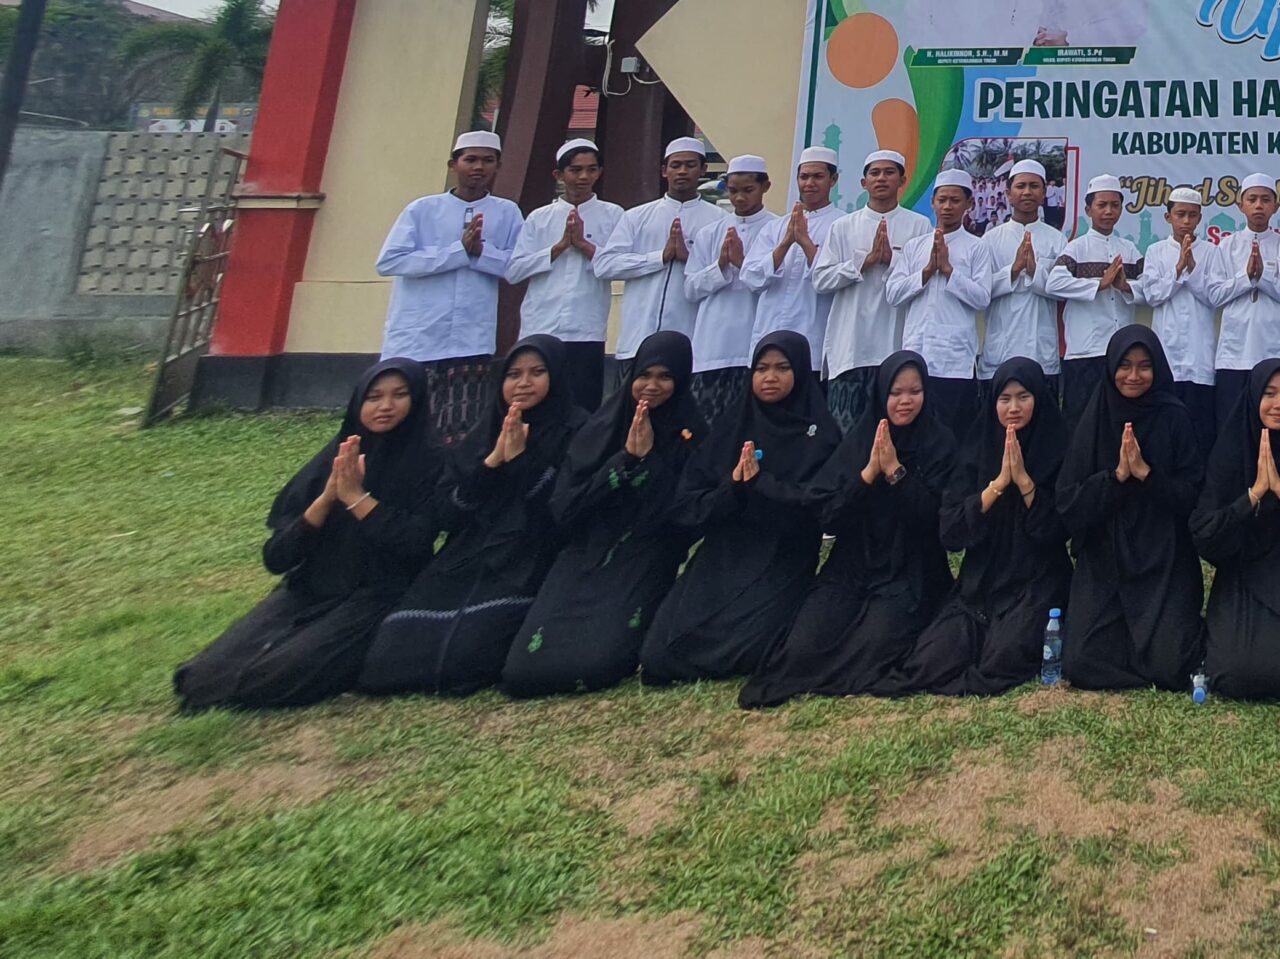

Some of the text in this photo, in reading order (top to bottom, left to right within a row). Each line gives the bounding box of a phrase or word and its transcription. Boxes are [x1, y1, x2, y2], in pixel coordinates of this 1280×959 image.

[978, 79, 1219, 119] PERINGATAN
[1111, 130, 1259, 156] KABUPATEN
[1119, 176, 1214, 214] “Jihd
